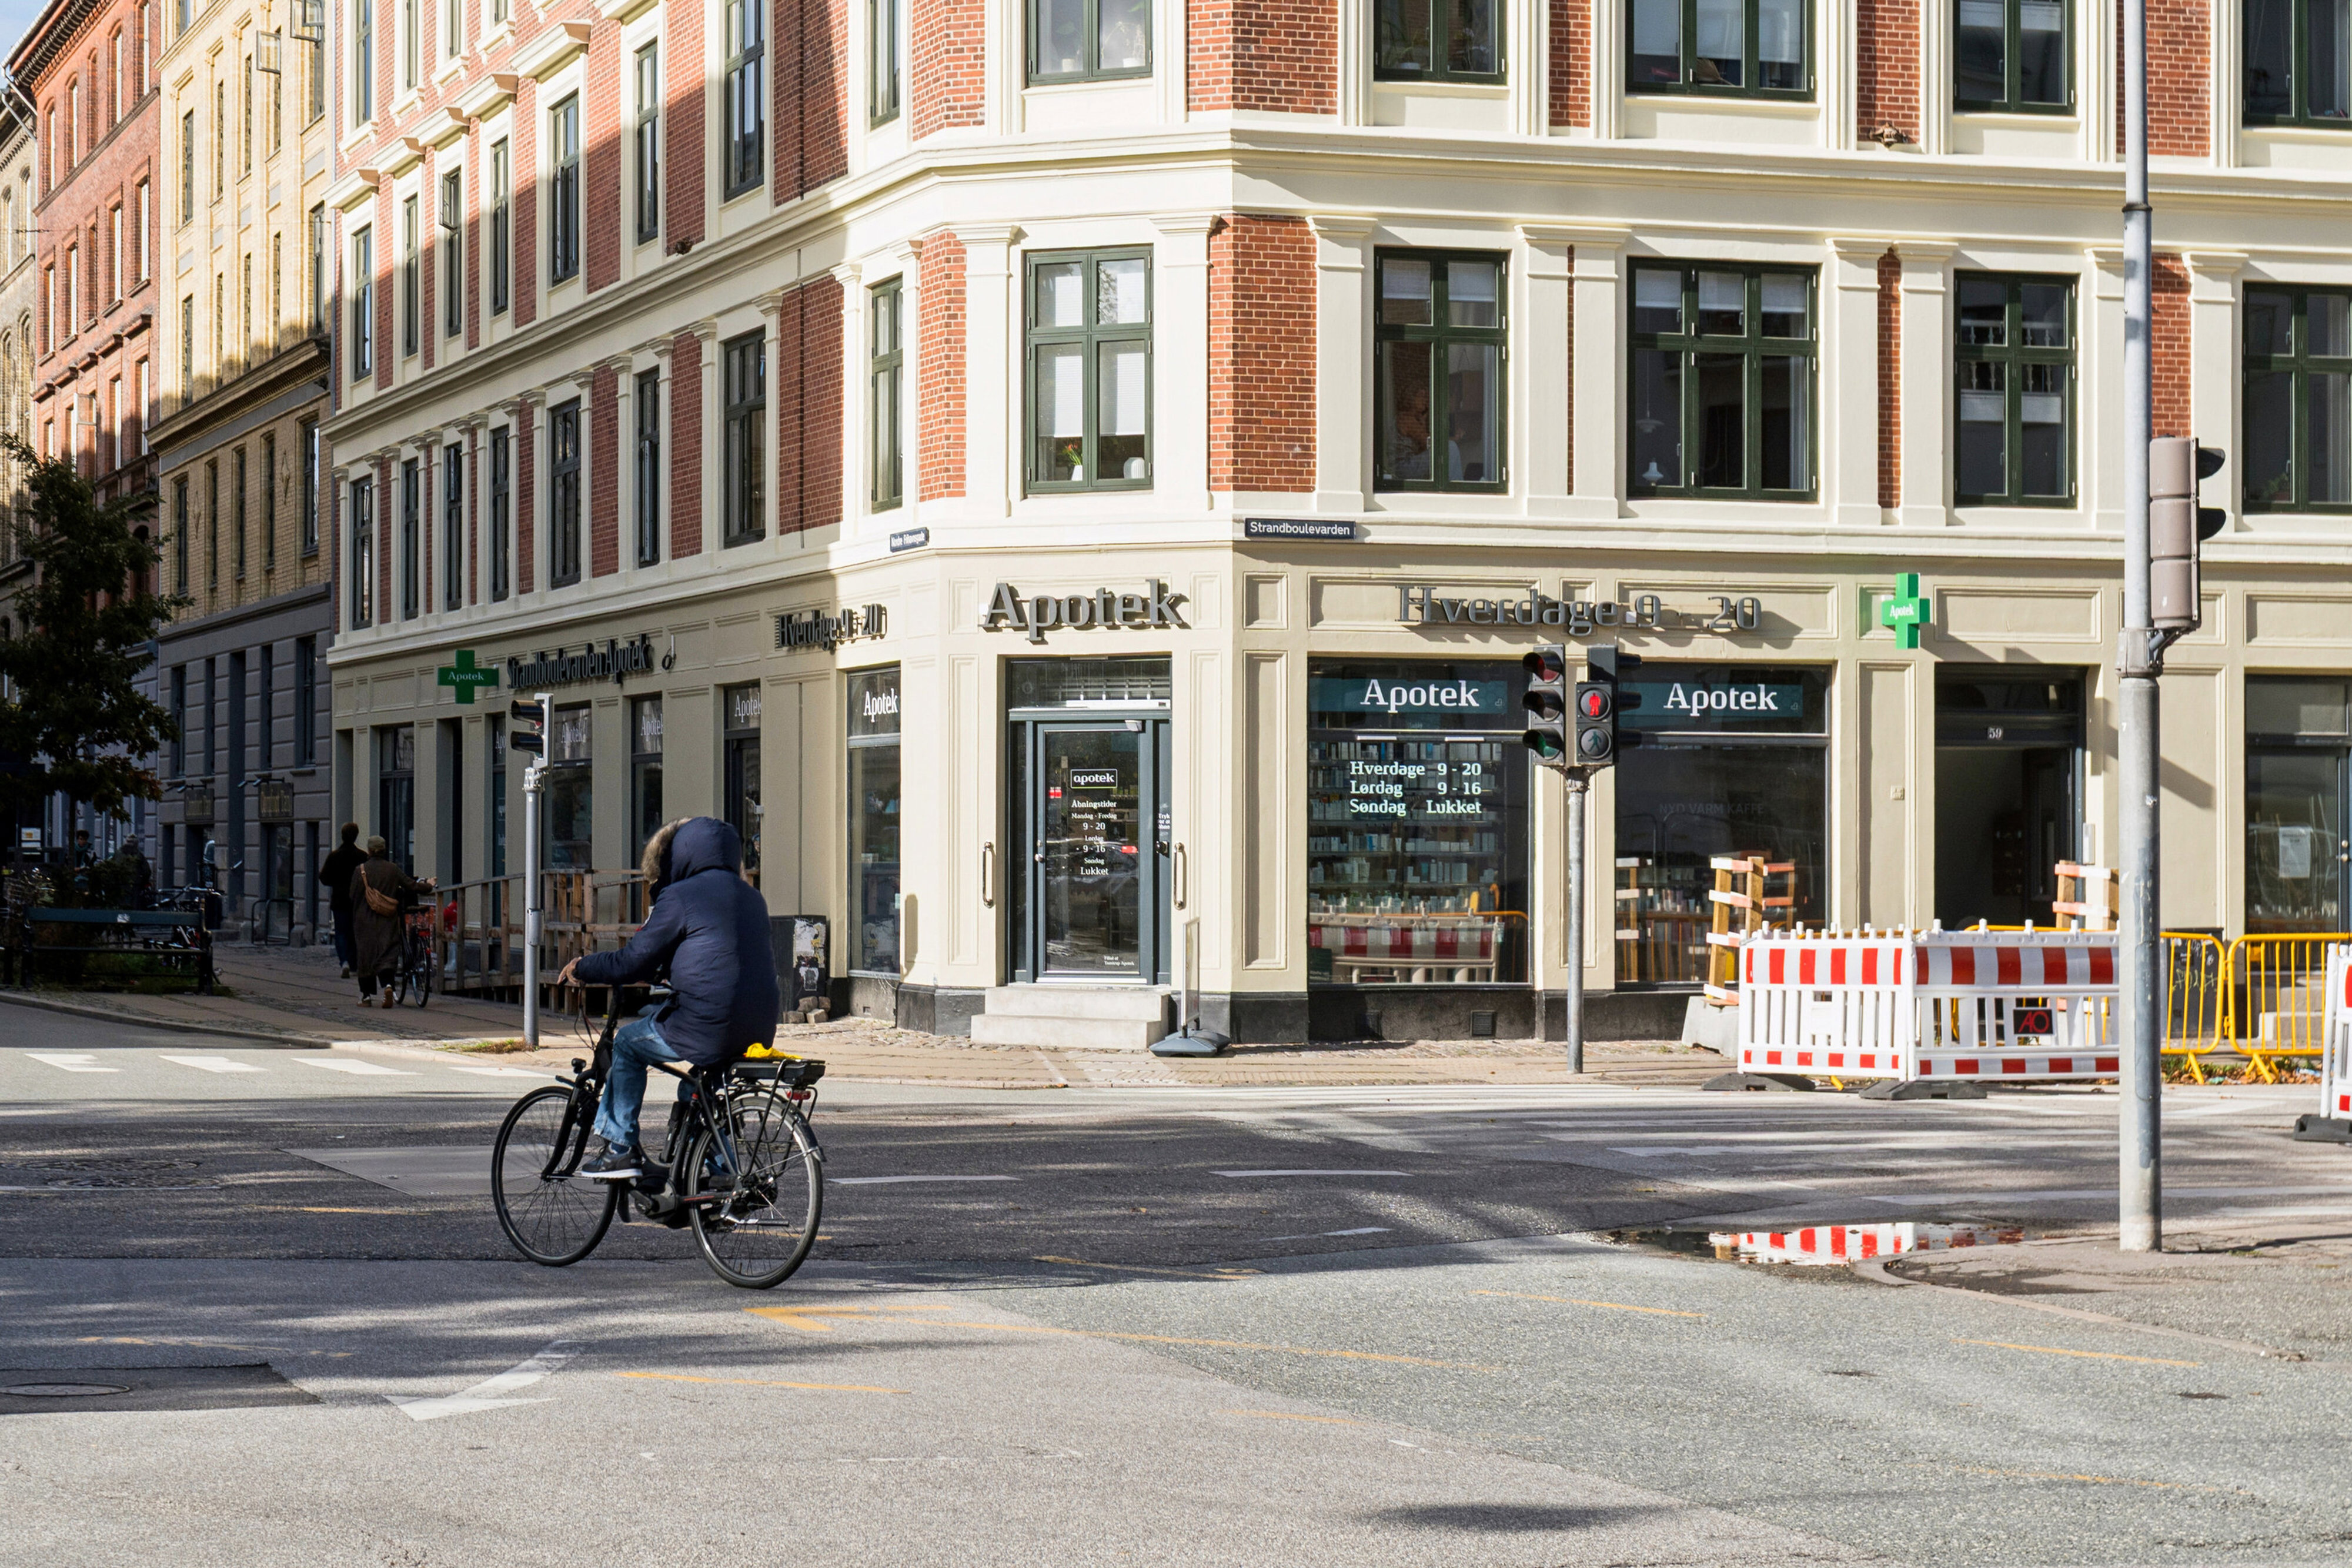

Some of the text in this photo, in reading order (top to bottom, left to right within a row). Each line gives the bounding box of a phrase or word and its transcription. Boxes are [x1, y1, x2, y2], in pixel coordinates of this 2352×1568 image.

[1250, 521, 1350, 536] Strandboulevarden
[977, 579, 1182, 641] Apotek
[1395, 586, 1618, 637] Hverdage
[1635, 594, 1661, 627] 9
[1708, 595, 1762, 630] 20
[1889, 603, 1915, 620] Apotek
[779, 609, 837, 651] Hverdage
[840, 608, 850, 638] 9
[861, 603, 880, 635] 20
[604, 634, 647, 684] Apotek
[447, 670, 485, 683] Apotek
[1360, 678, 1479, 714] Apotek
[1663, 683, 1778, 716] Apotek
[863, 687, 899, 723] Apotek
[1989, 727, 2002, 740] 59
[1349, 761, 1426, 778] Hverdage
[1437, 763, 1447, 775] 9
[1462, 763, 1482, 775] 20
[1073, 773, 1115, 785] apotek
[1349, 781, 1403, 797] Lørdag
[1437, 782, 1447, 794] 9
[1462, 782, 1482, 795] 16
[1349, 800, 1482, 816] Søndag Lukket
[1659, 803, 1765, 814] NYD VARM KAFFE
[1083, 822, 1088, 830] 9
[1095, 822, 1105, 830] 20
[1080, 867, 1109, 875] Lukket
[2018, 1010, 2050, 1034] AO
